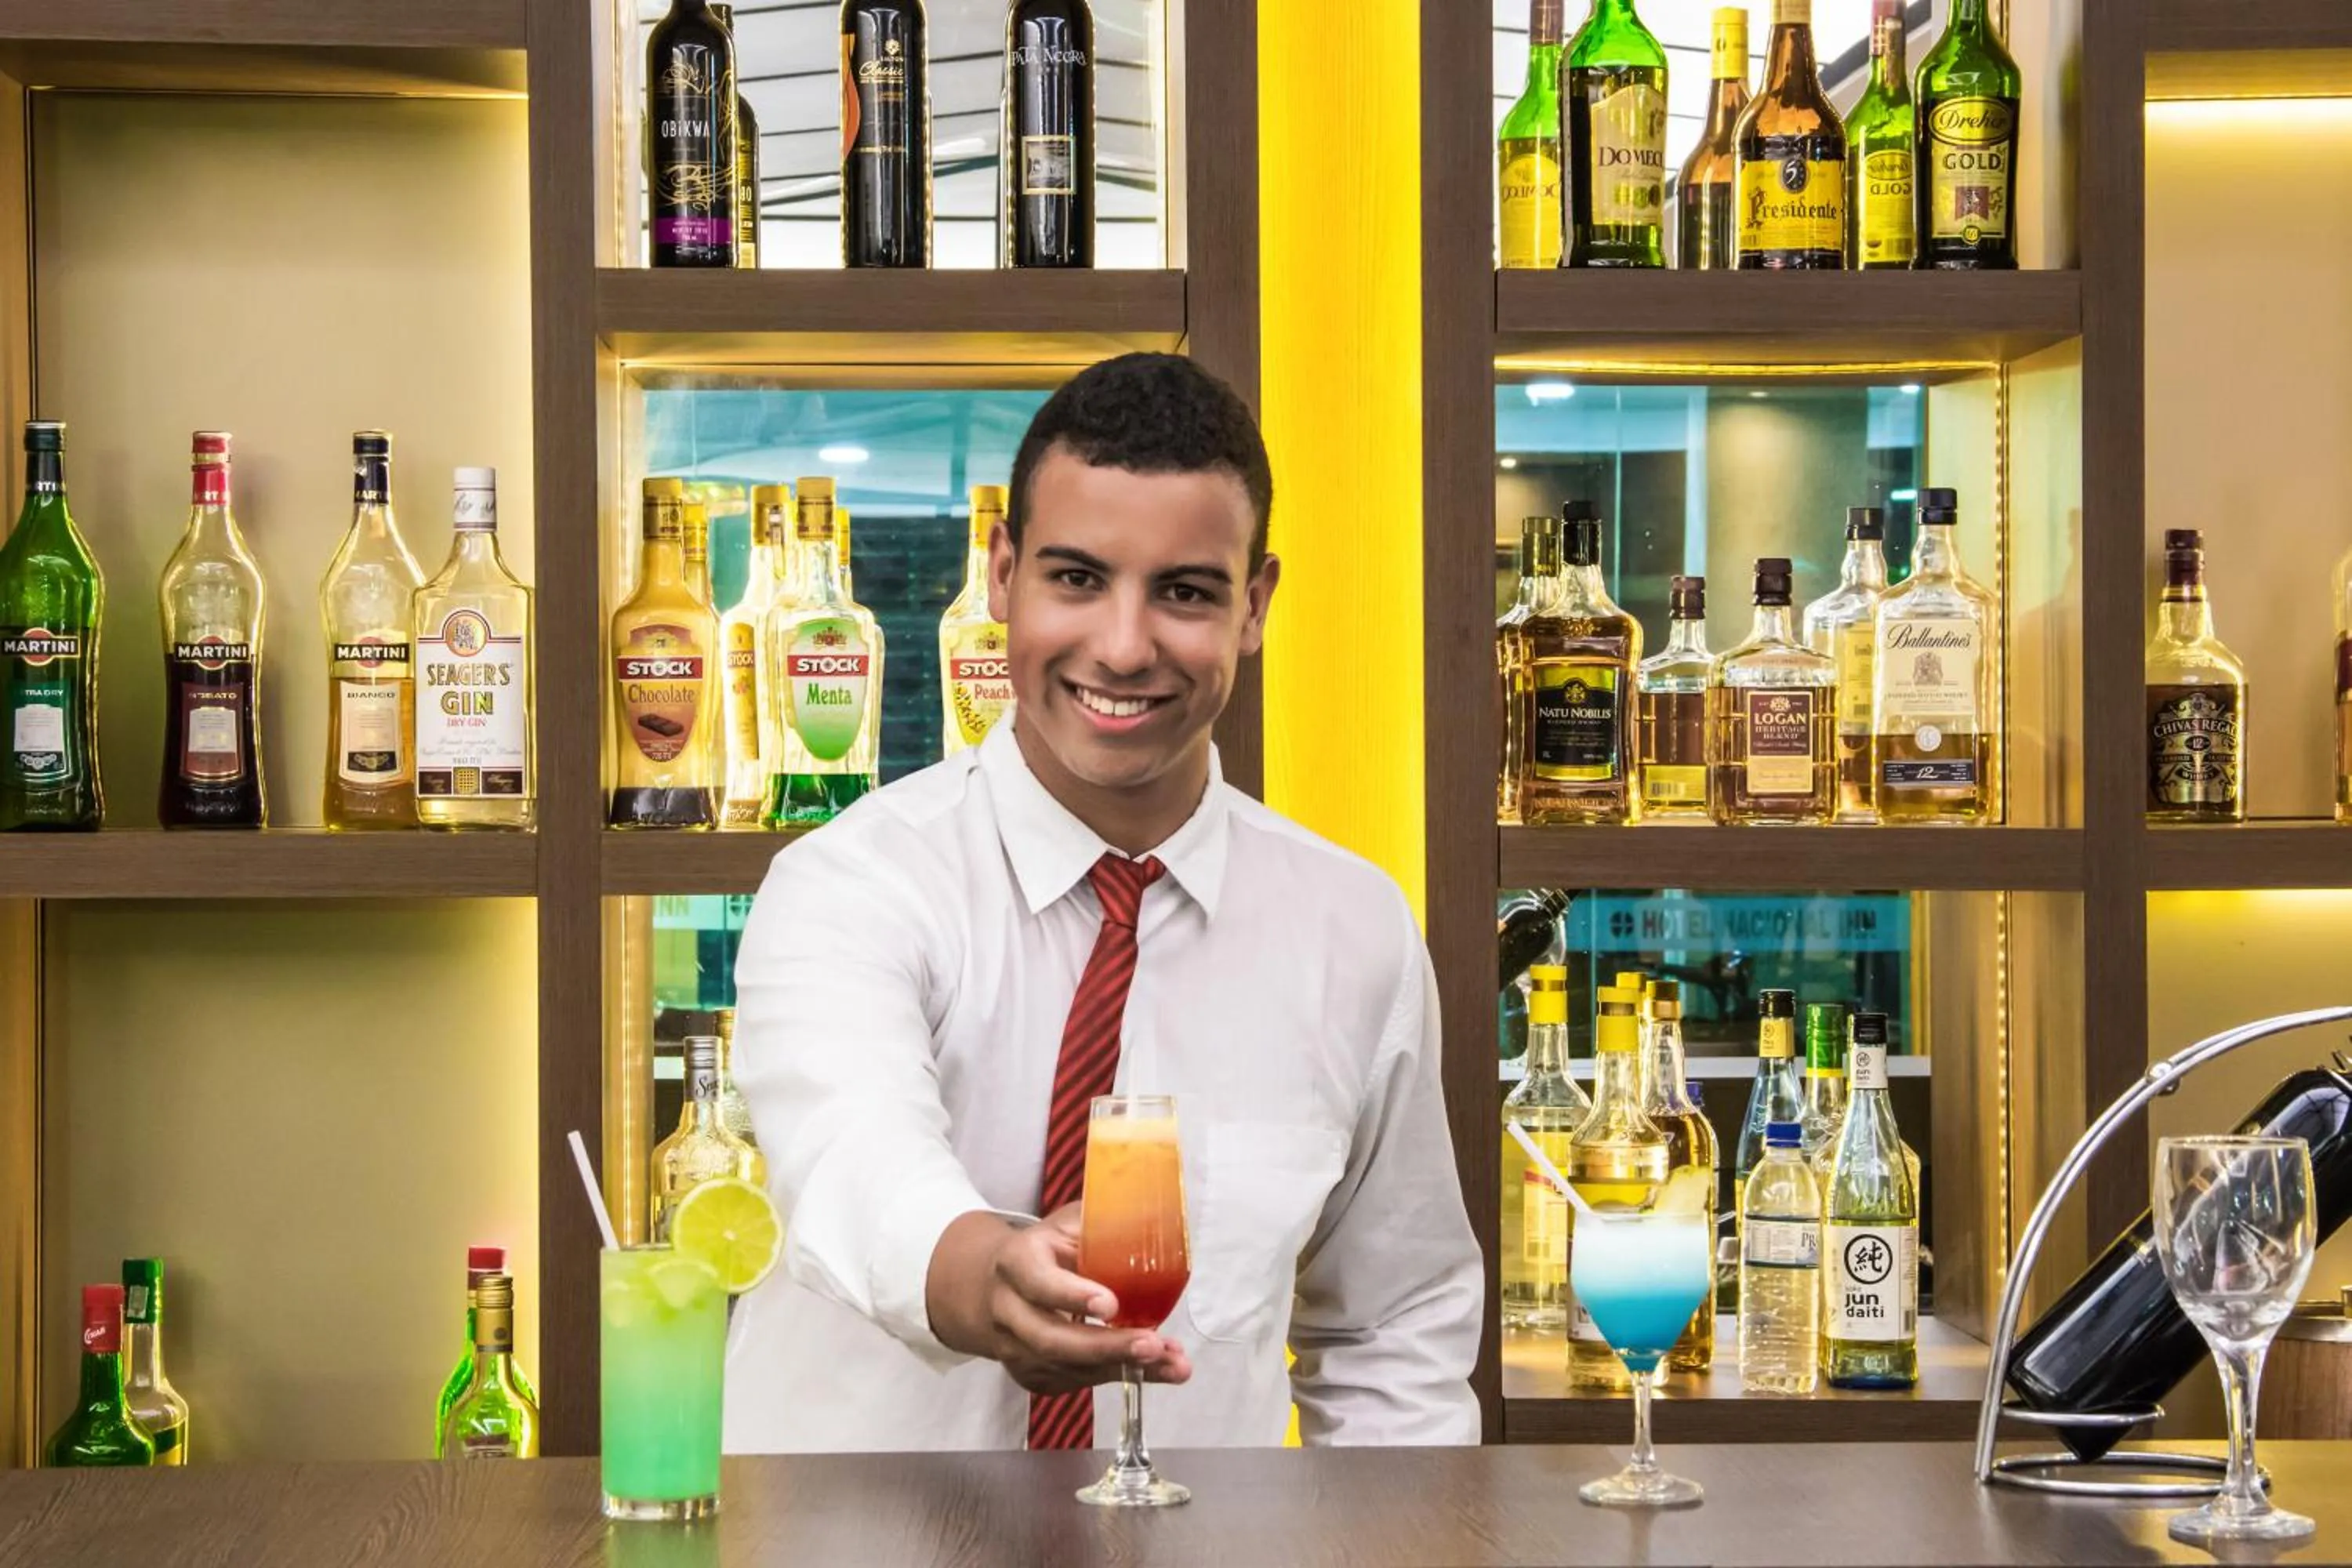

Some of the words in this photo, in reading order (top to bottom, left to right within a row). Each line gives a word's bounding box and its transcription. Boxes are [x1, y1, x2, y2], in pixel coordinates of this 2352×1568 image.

[1942, 152, 2002, 170] GOLD
[1784, 161, 1798, 184] 5
[1745, 187, 1837, 229] Presidente
[4, 640, 75, 653] MARTINI
[177, 645, 247, 658] MARTINI
[337, 646, 405, 659] MARTINI
[626, 660, 693, 677] STOCK
[797, 657, 860, 673] STOCK
[959, 661, 1009, 677] STOC
[628, 684, 695, 703] Chocolate
[806, 683, 852, 705] Menta
[975, 684, 1010, 700] Peach
[441, 691, 493, 715] GIN
[1539, 707, 1568, 719] NATU
[1570, 708, 1612, 720] NOBILIS
[1754, 712, 1806, 725] LOGAN
[2153, 719, 2199, 737] CHIVAS
[1915, 766, 1939, 779] 12
[1845, 1294, 1879, 1308] jun
[1846, 1306, 1885, 1318] daiti
